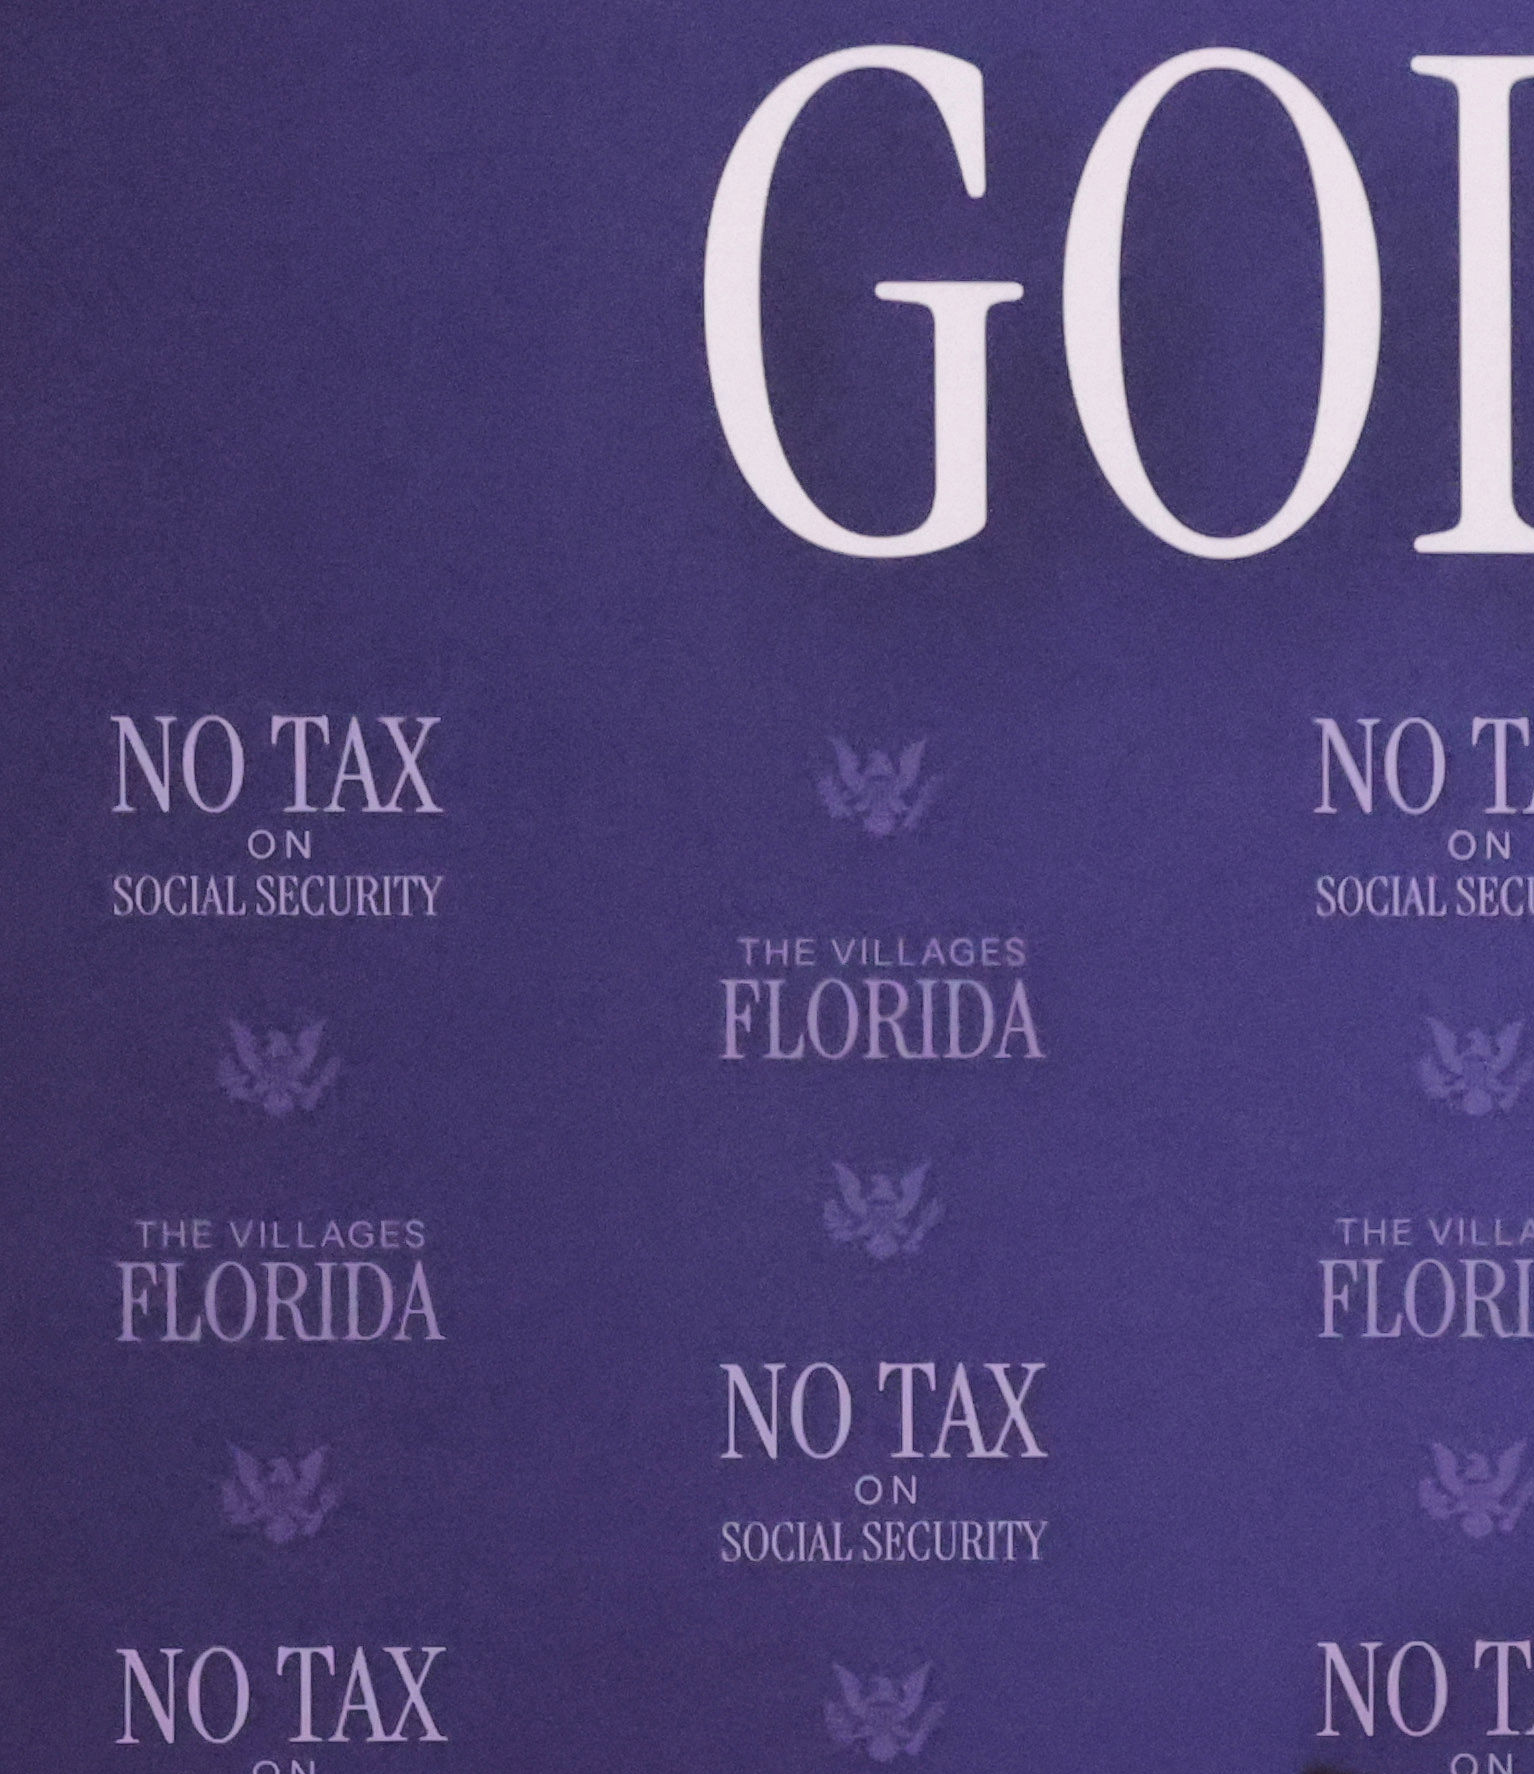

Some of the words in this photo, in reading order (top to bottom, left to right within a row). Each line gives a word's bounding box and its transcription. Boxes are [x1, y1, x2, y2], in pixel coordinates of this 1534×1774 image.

[111, 715, 244, 812] NO
[271, 715, 442, 812] TAX
[1315, 718, 1445, 814] NO
[248, 829, 311, 859] ON
[1448, 830, 1510, 860] ON
[114, 876, 246, 915] SOCIAL
[257, 875, 443, 916] SECURITY
[1317, 876, 1446, 916] SOCIAL
[738, 937, 815, 966] THE
[831, 937, 1025, 966] VILLAGES
[722, 978, 1044, 1059] FLORIDA
[136, 1219, 210, 1249] THE
[230, 1219, 425, 1249] VILLAGES
[1336, 1218, 1411, 1246] THE
[118, 1261, 444, 1342] FLORIDA
[721, 1363, 851, 1459] NO
[879, 1362, 1047, 1457] TAX
[854, 1475, 916, 1505] ON
[722, 1522, 852, 1561] SOCIAL
[863, 1520, 1047, 1561] SECURITY
[117, 1647, 249, 1743] NO
[277, 1646, 447, 1741] TAX
[1318, 1641, 1447, 1736] NO
